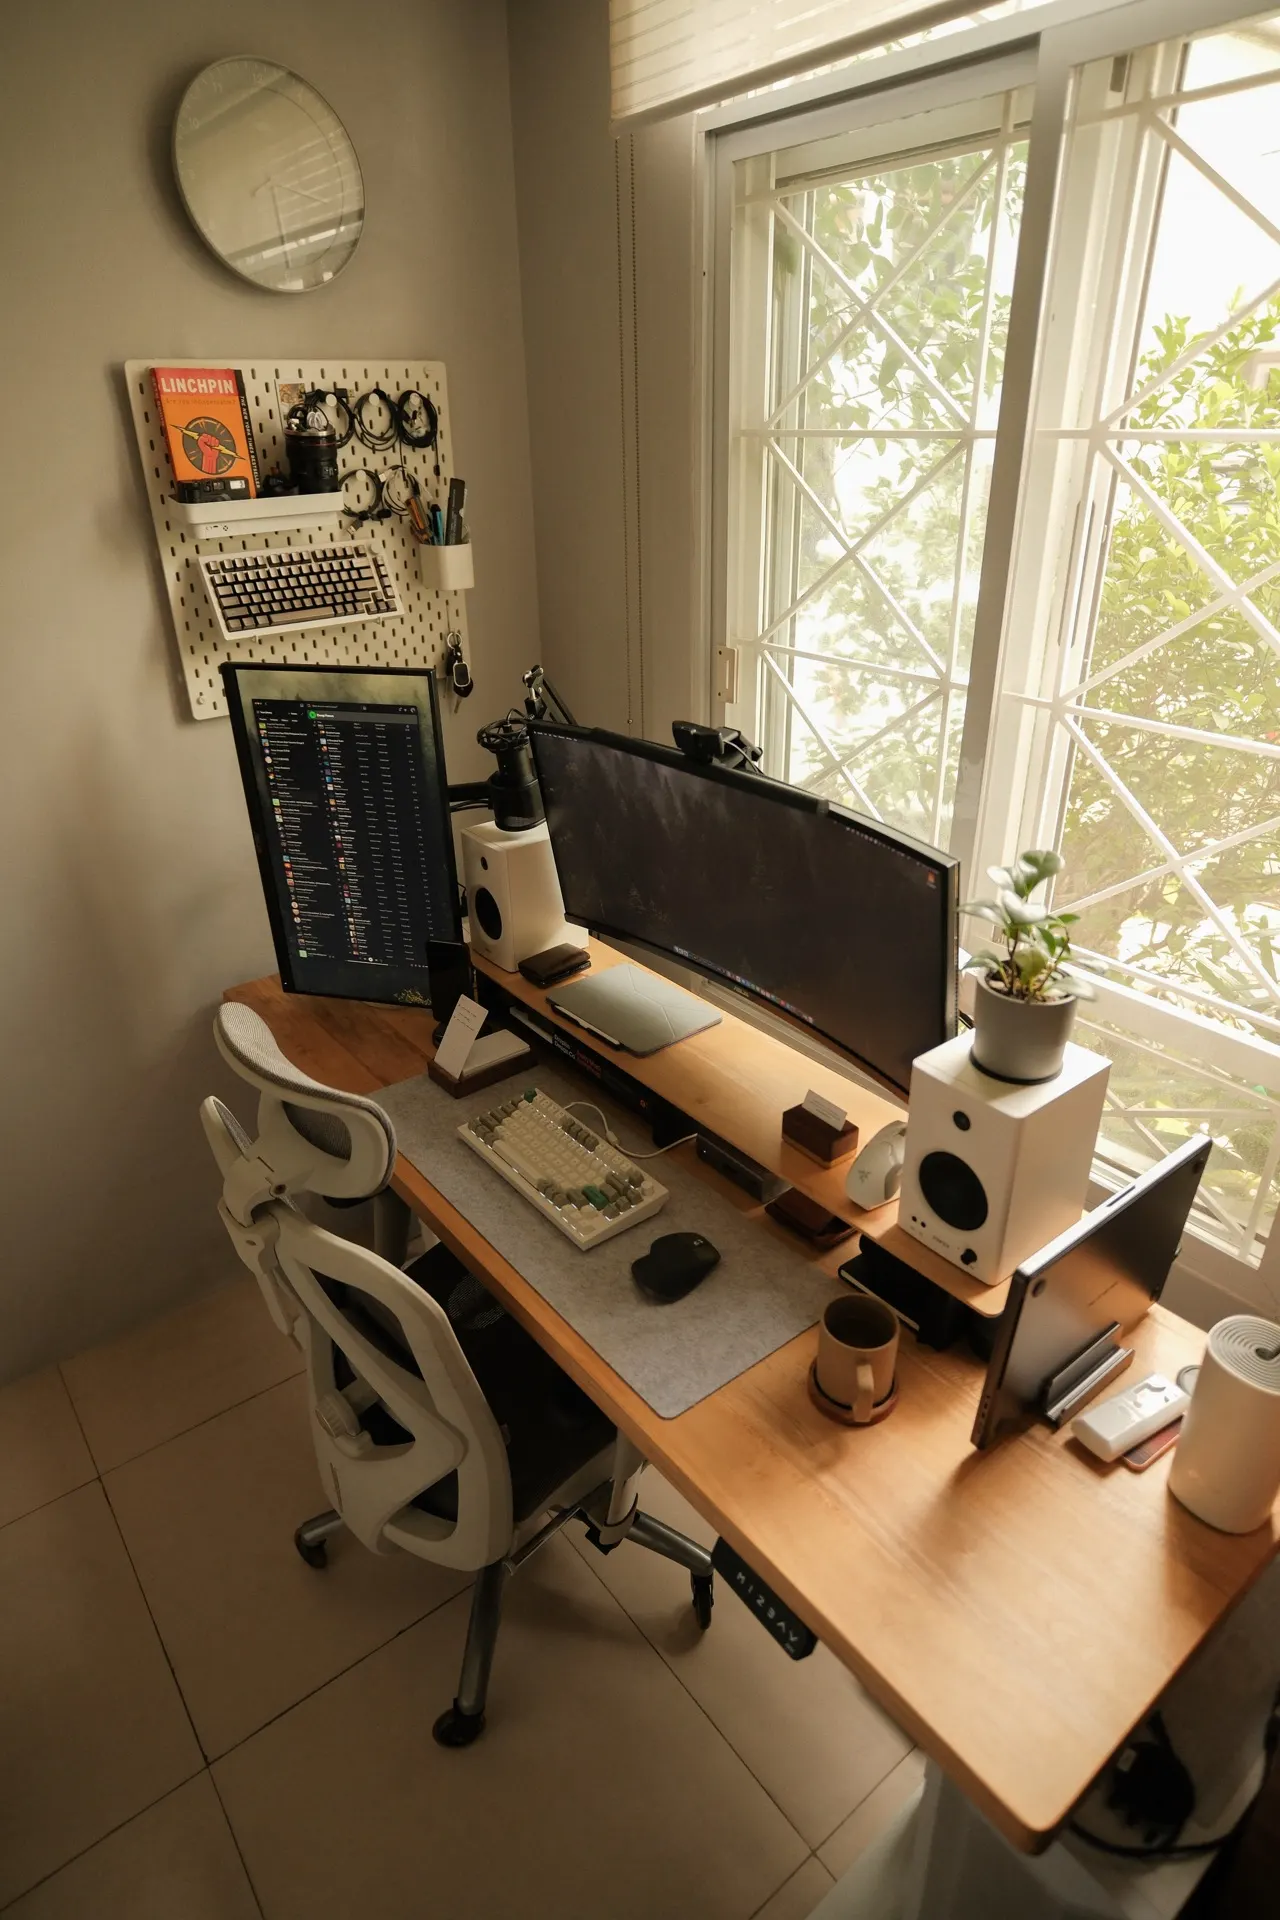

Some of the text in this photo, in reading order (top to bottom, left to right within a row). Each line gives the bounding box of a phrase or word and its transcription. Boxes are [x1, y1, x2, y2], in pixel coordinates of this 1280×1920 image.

[161, 377, 234, 394] LINCHPIN
[250, 454, 261, 489] BESTSELLER
[756, 1595, 765, 1607] 2
[767, 1606, 776, 1619] 3
